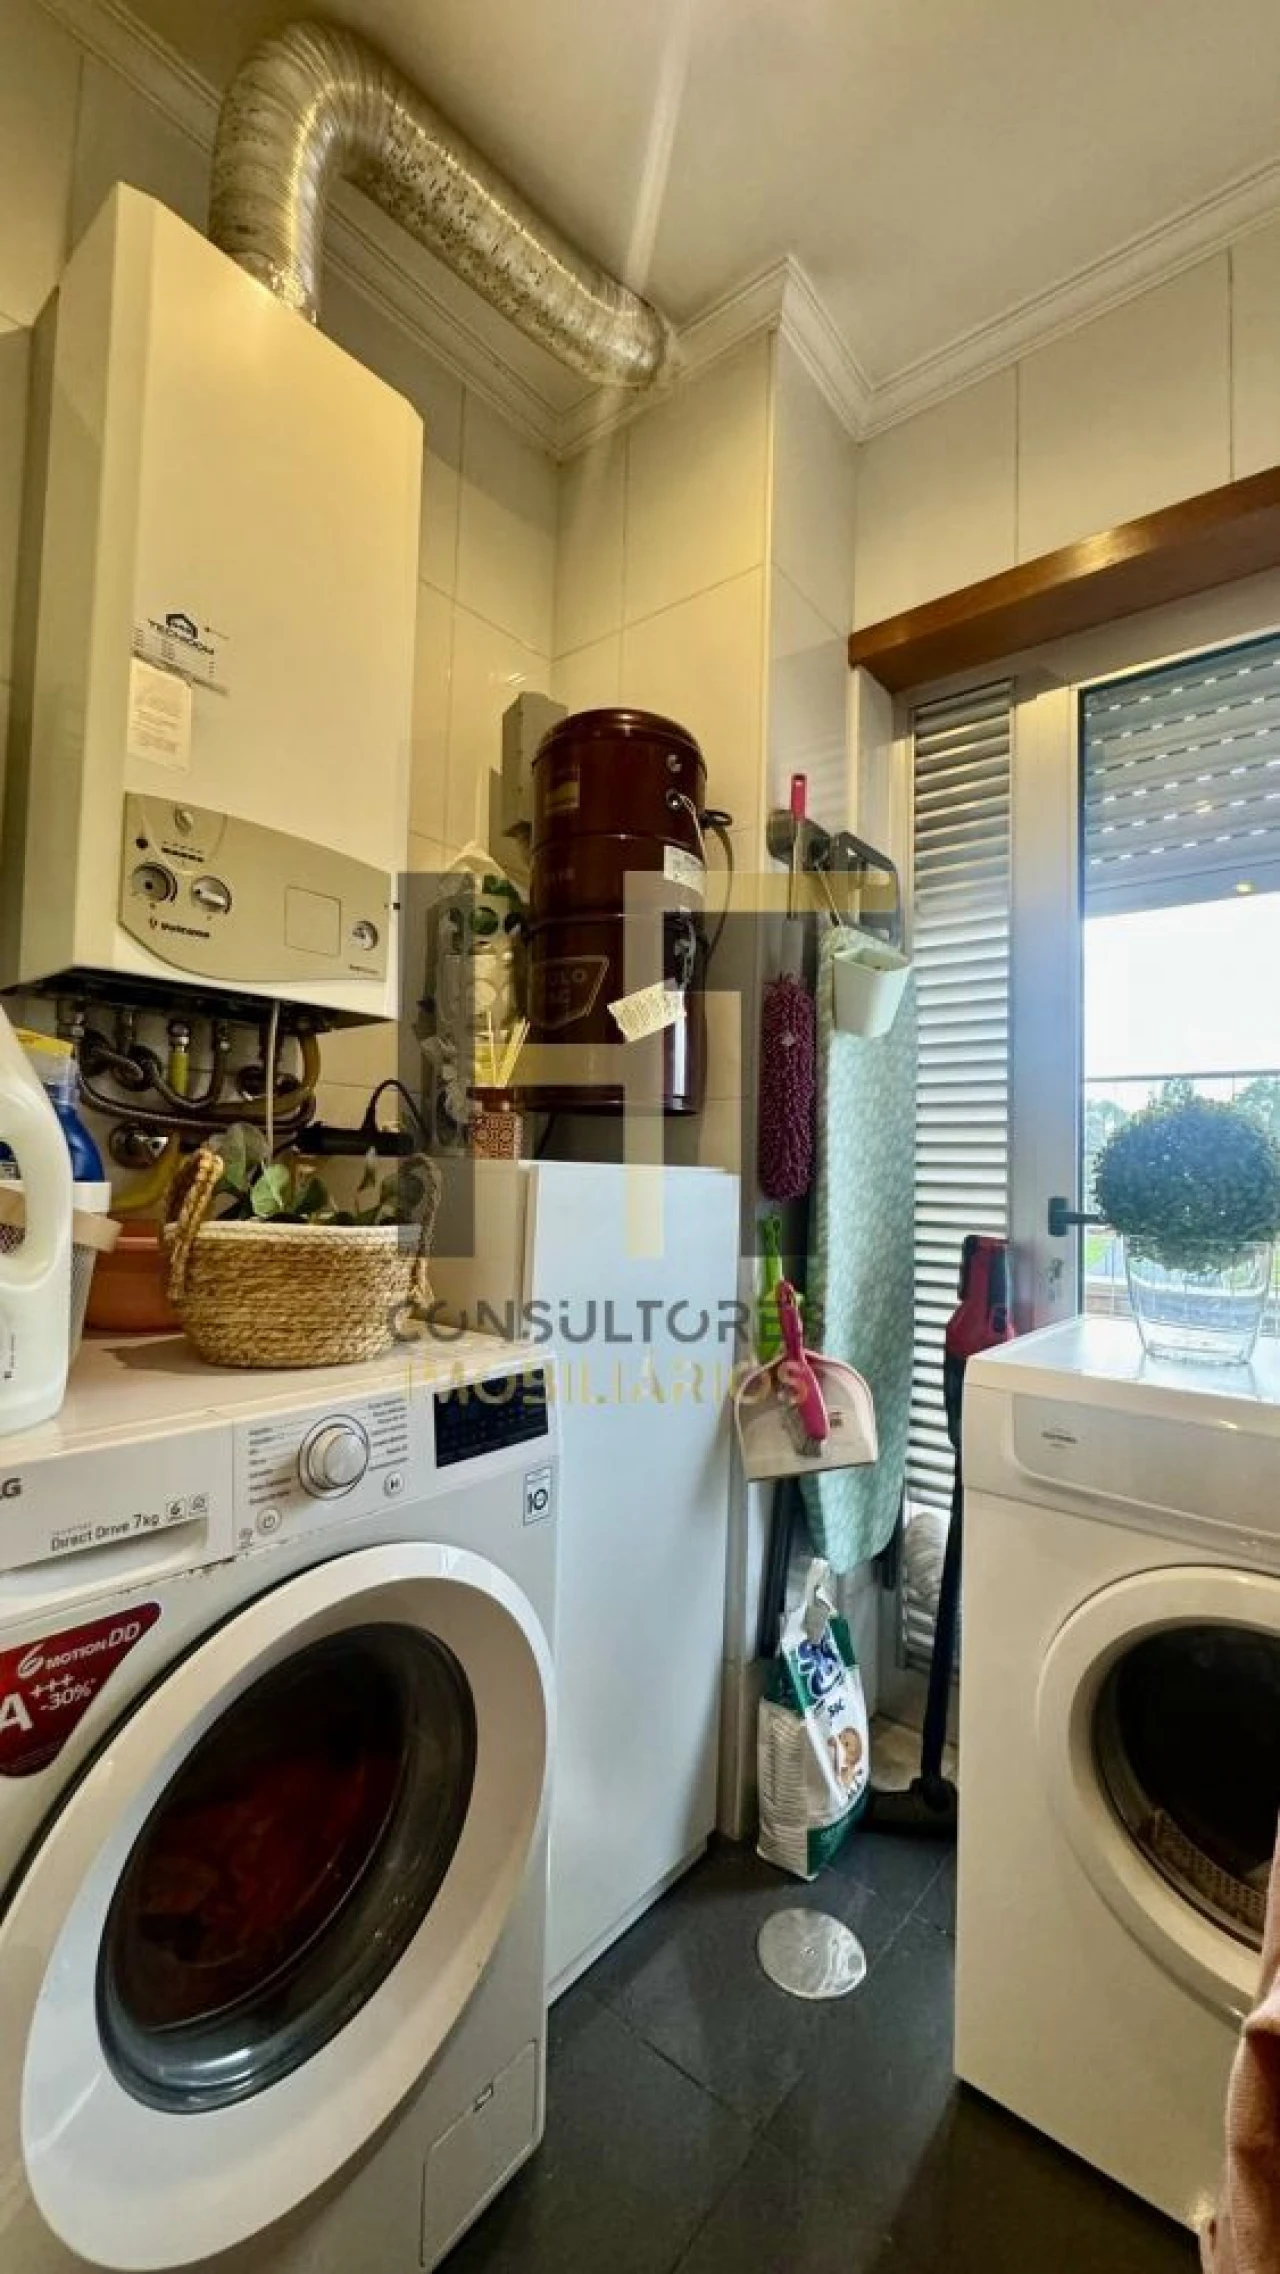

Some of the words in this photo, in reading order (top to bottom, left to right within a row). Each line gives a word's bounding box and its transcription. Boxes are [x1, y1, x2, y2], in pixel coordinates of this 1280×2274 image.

[0, 1478, 22, 1499] G
[51, 1530, 92, 1551] Direct
[95, 1521, 130, 1540] Drive
